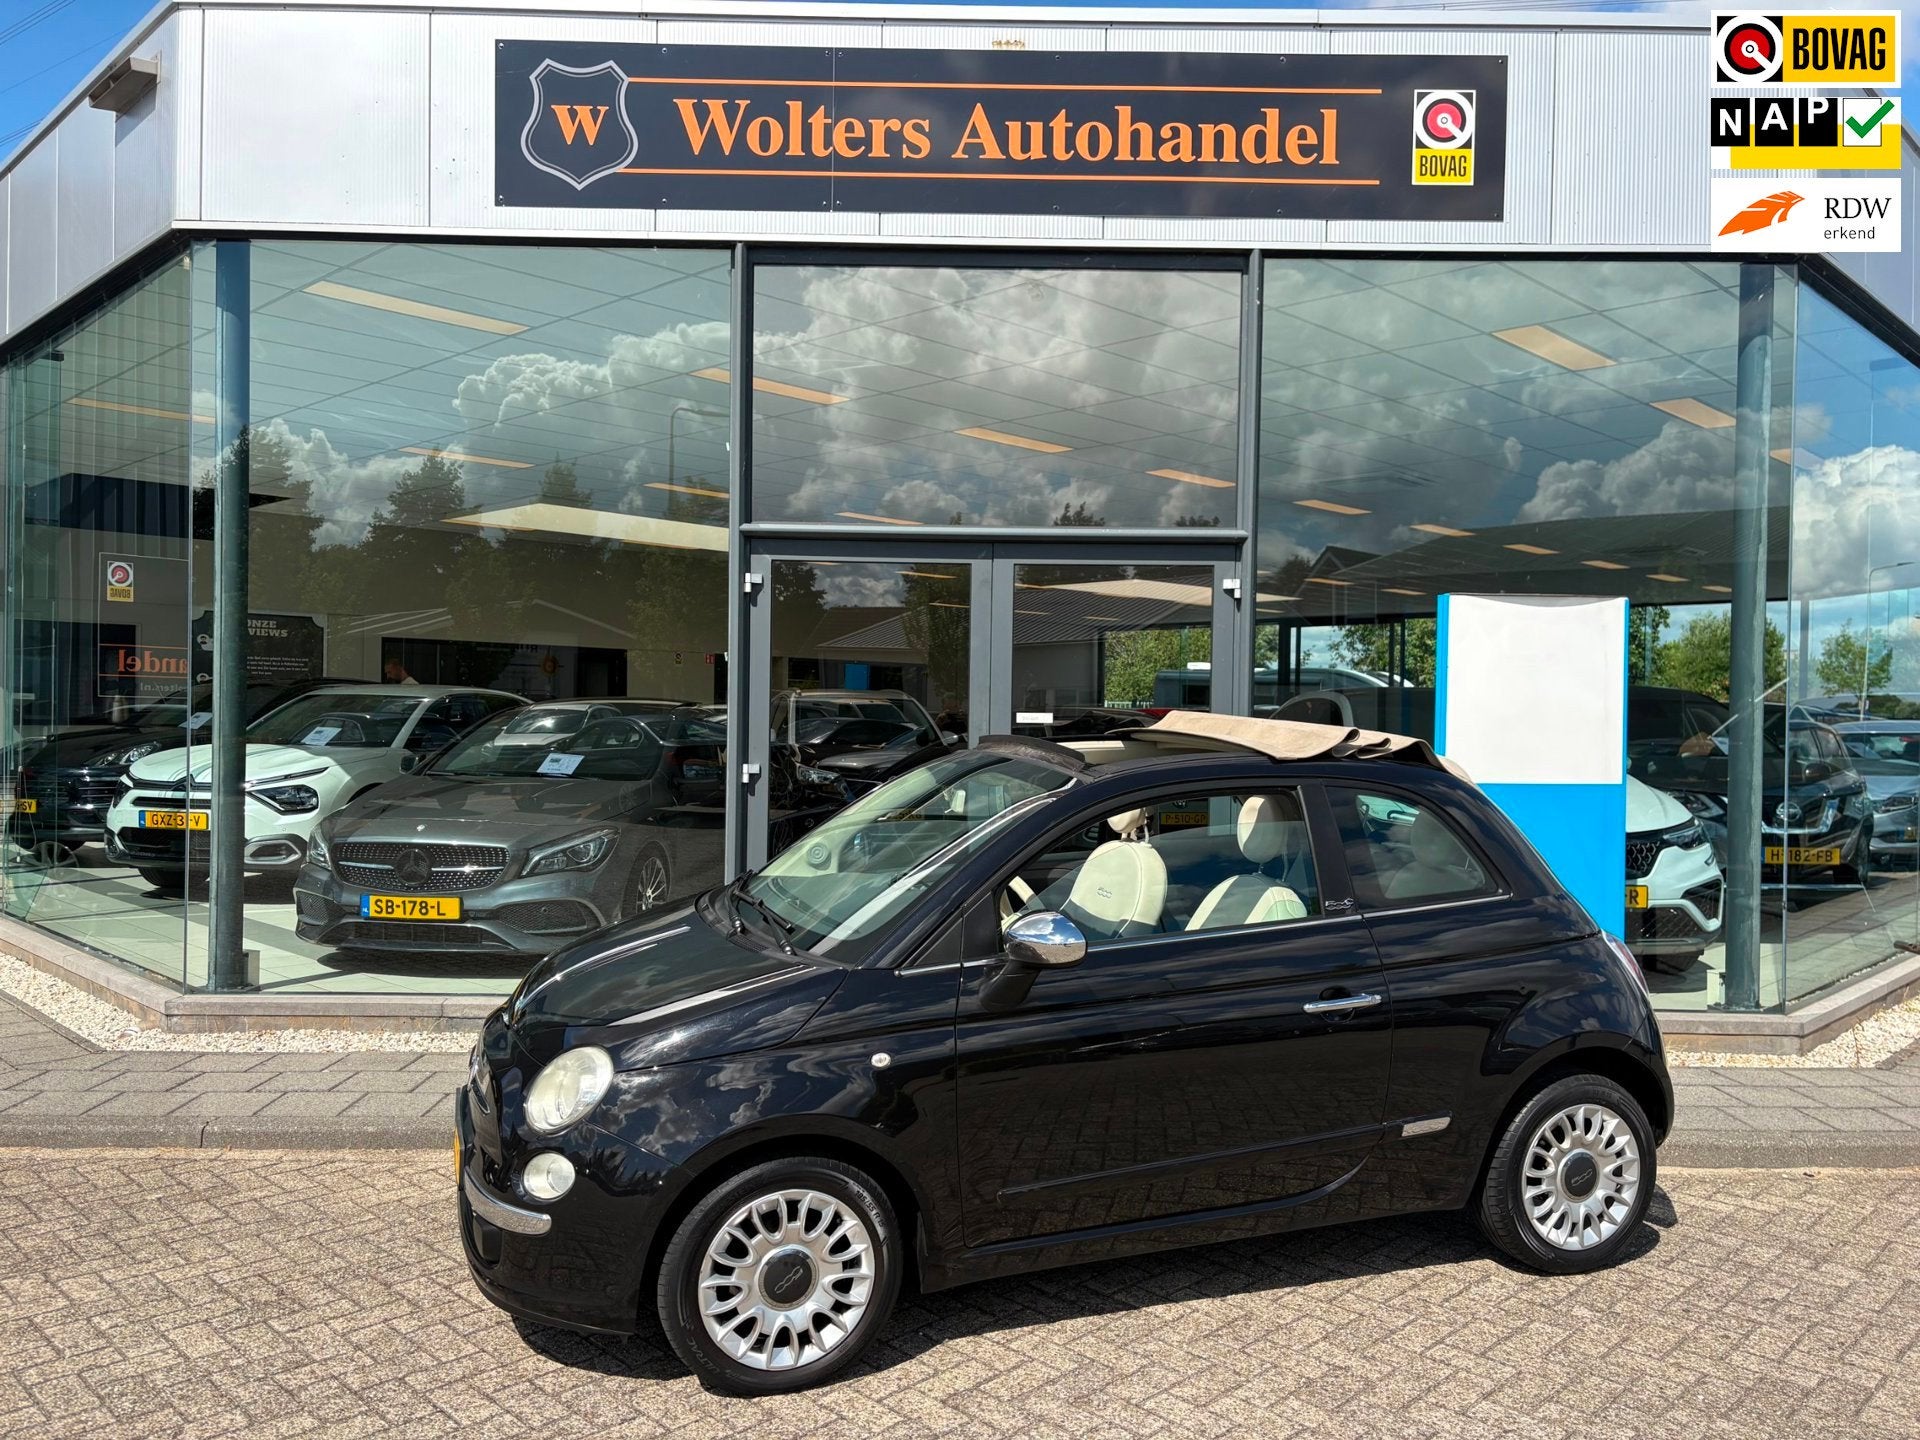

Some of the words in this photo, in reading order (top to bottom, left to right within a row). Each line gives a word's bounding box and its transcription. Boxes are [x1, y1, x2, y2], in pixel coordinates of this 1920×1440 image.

[551, 104, 609, 146] W
[673, 98, 931, 159] Wolters
[951, 102, 1340, 165] Autohandel
[1420, 155, 1467, 177] BOVAG
[152, 814, 201, 827] GXZ-3-V
[1771, 849, 1833, 862] H-182-FB
[374, 899, 446, 916] SB-178-L
